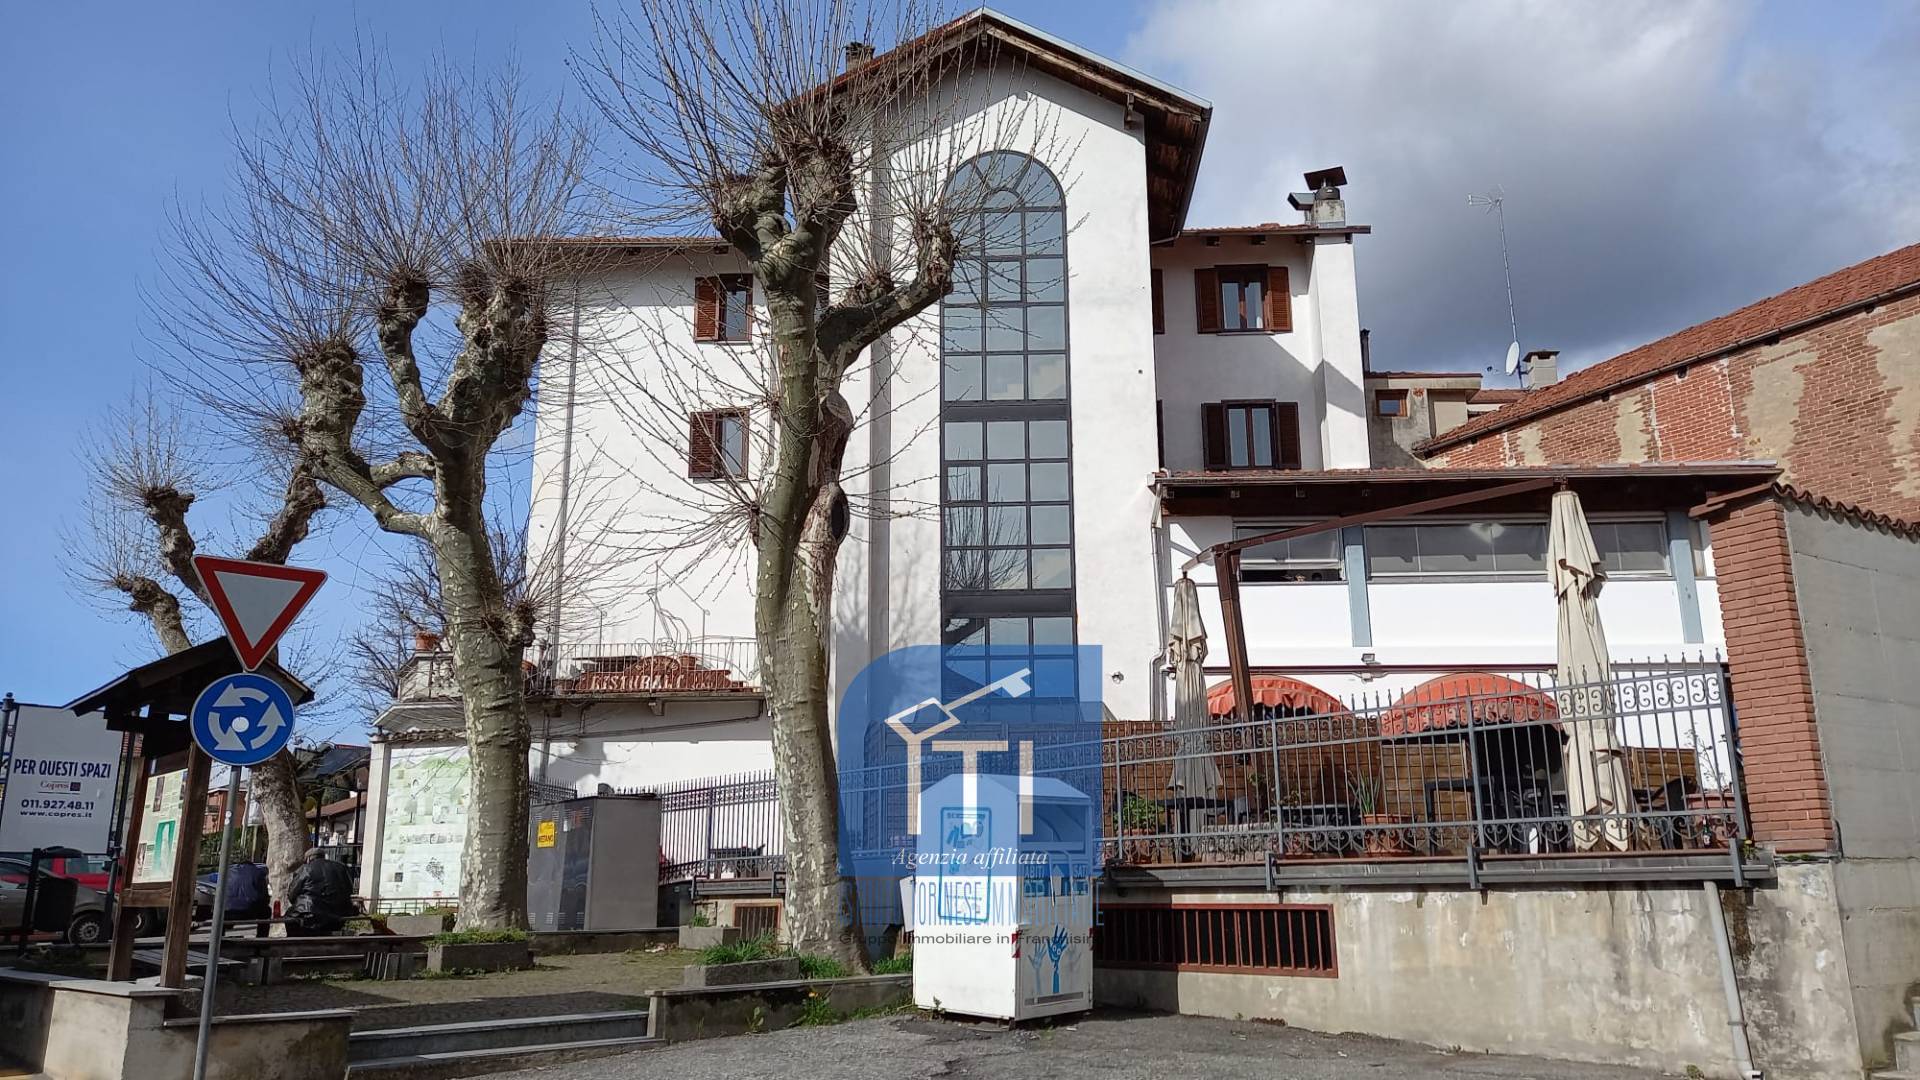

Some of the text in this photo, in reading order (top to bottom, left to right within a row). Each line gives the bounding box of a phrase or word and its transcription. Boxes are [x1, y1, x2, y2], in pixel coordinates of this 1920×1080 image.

[13, 758, 112, 779] PER QUESTI SPAZI
[40, 780, 70, 791] Copres
[21, 799, 94, 811] 011.927.48.11
[20, 811, 92, 819] www.copres.it
